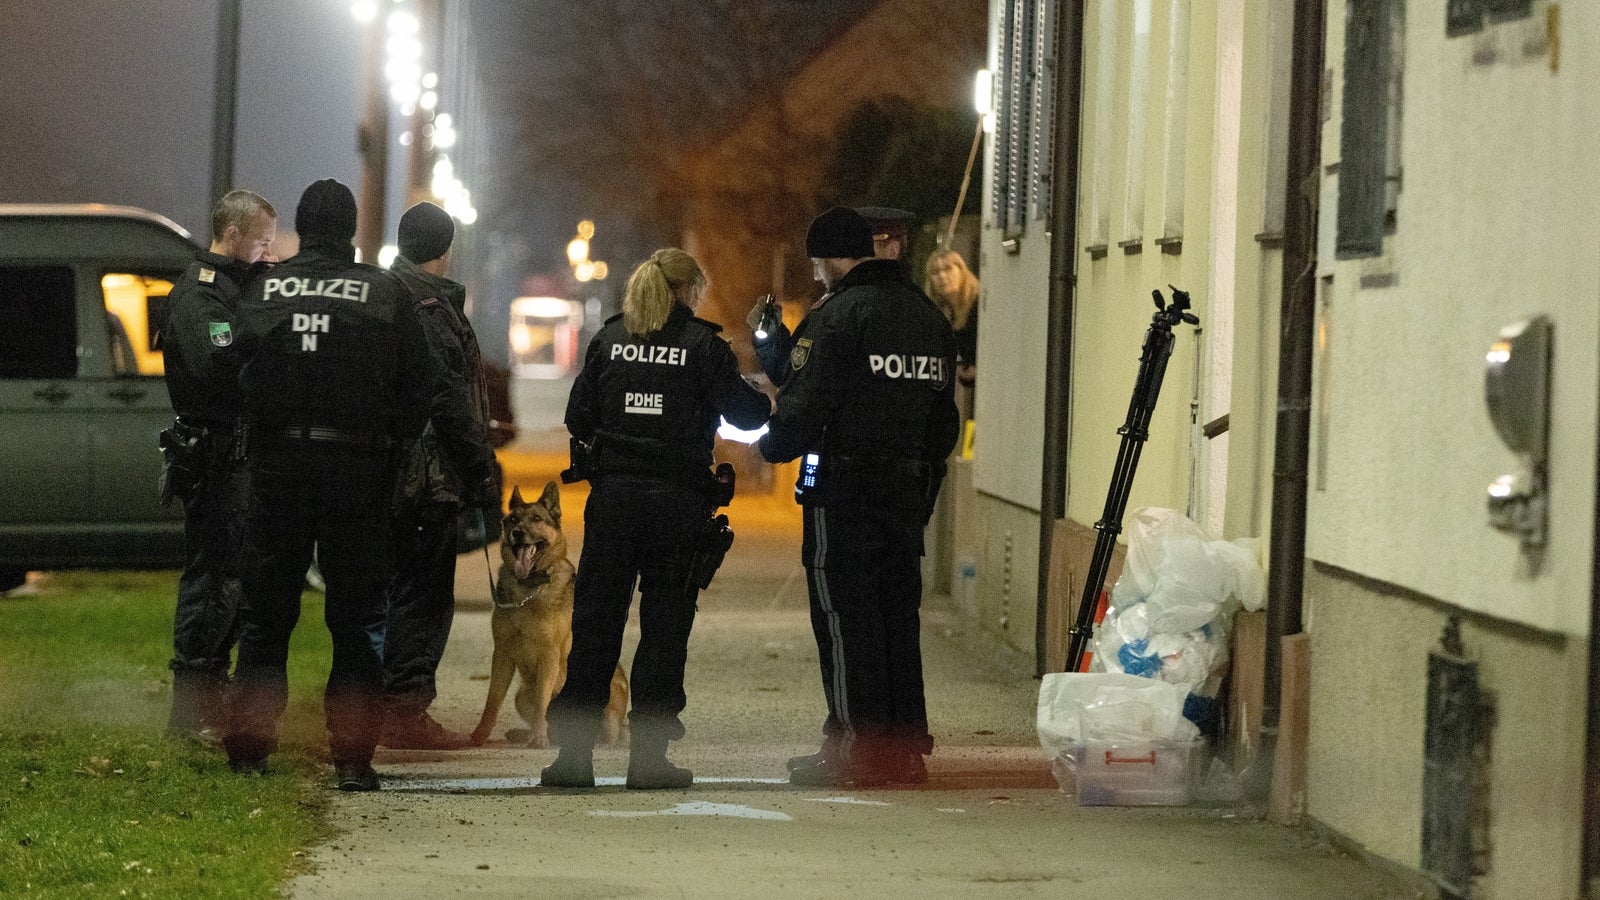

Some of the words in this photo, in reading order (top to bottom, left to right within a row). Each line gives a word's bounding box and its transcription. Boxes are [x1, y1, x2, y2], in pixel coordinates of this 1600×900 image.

[263, 276, 370, 302] POLIZEI
[292, 313, 330, 333] DH
[302, 334, 317, 351] N
[610, 343, 687, 366] POLIZEI
[869, 354, 943, 381] POLIZEI
[625, 392, 663, 408] PDHE
